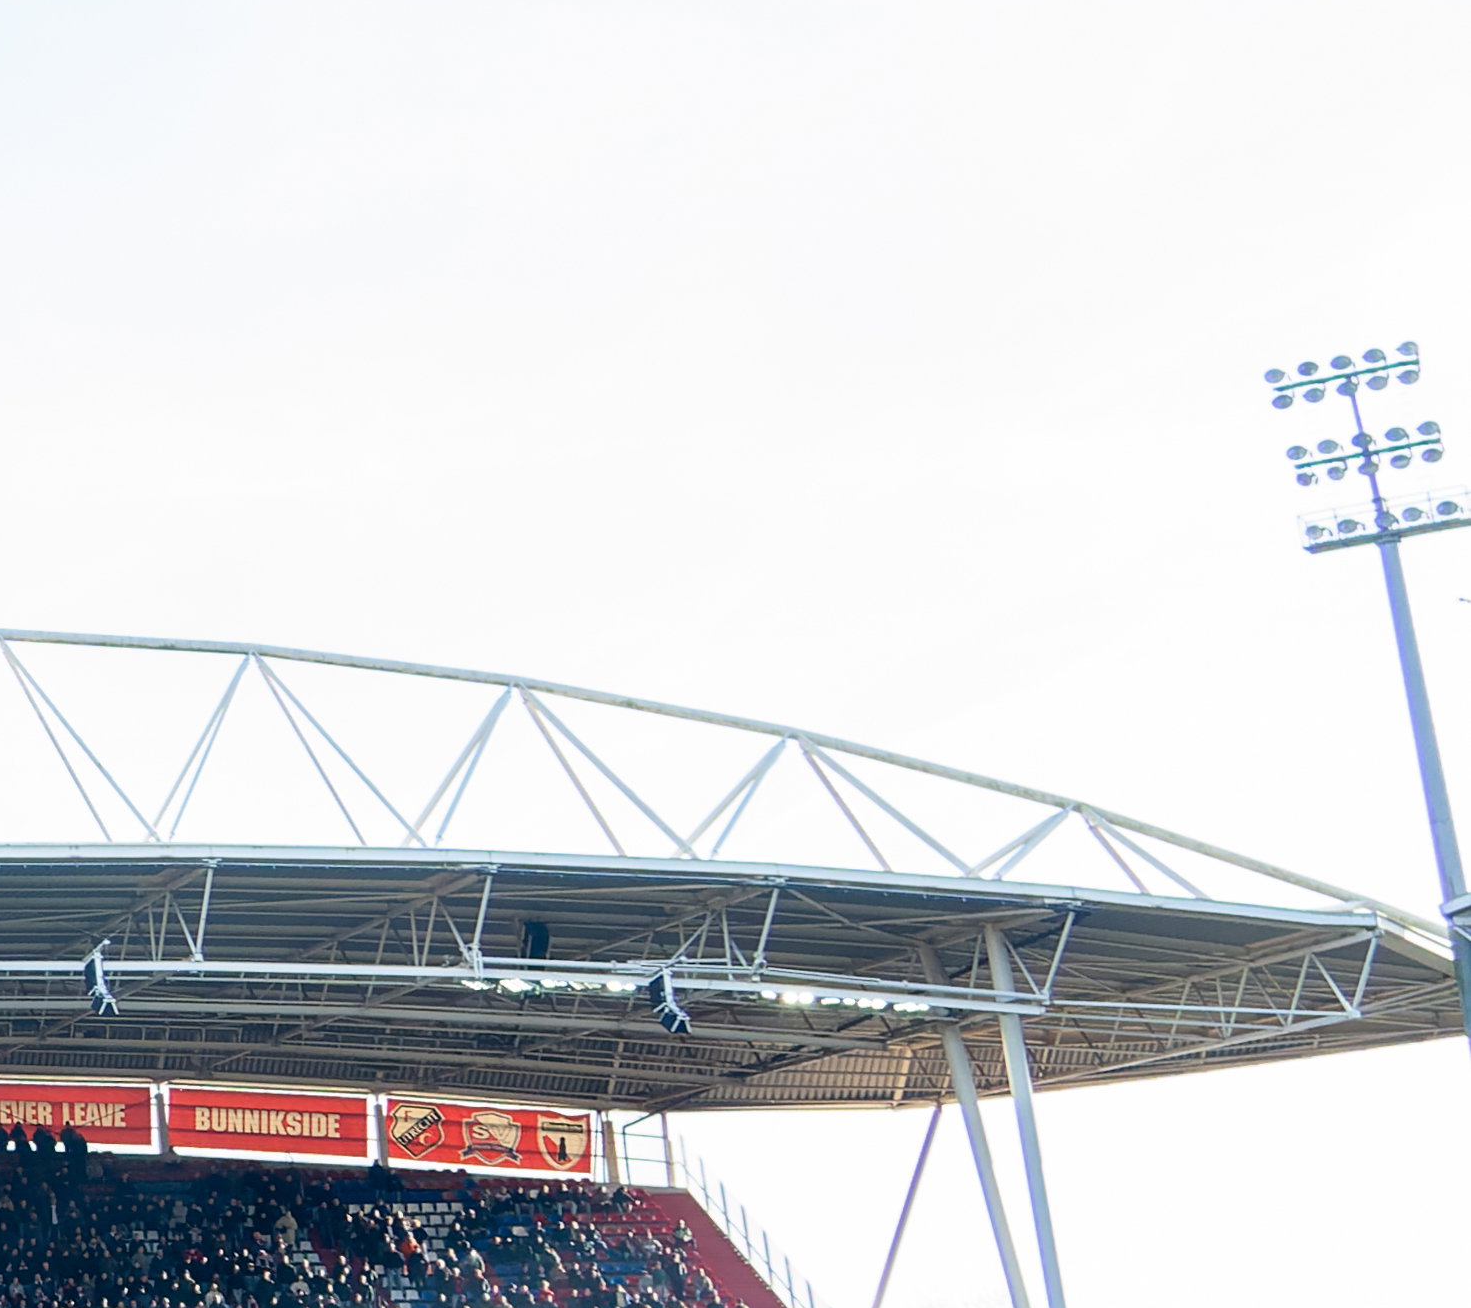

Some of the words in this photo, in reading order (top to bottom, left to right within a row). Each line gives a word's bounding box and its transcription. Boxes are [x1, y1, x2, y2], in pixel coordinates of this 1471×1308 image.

[62, 1102, 127, 1128] LEAVE
[194, 1107, 341, 1139] BUNNIKSIDE
[397, 1110, 439, 1145] UTRECHT
[404, 1110, 412, 1123] F
[419, 1132, 433, 1146] C
